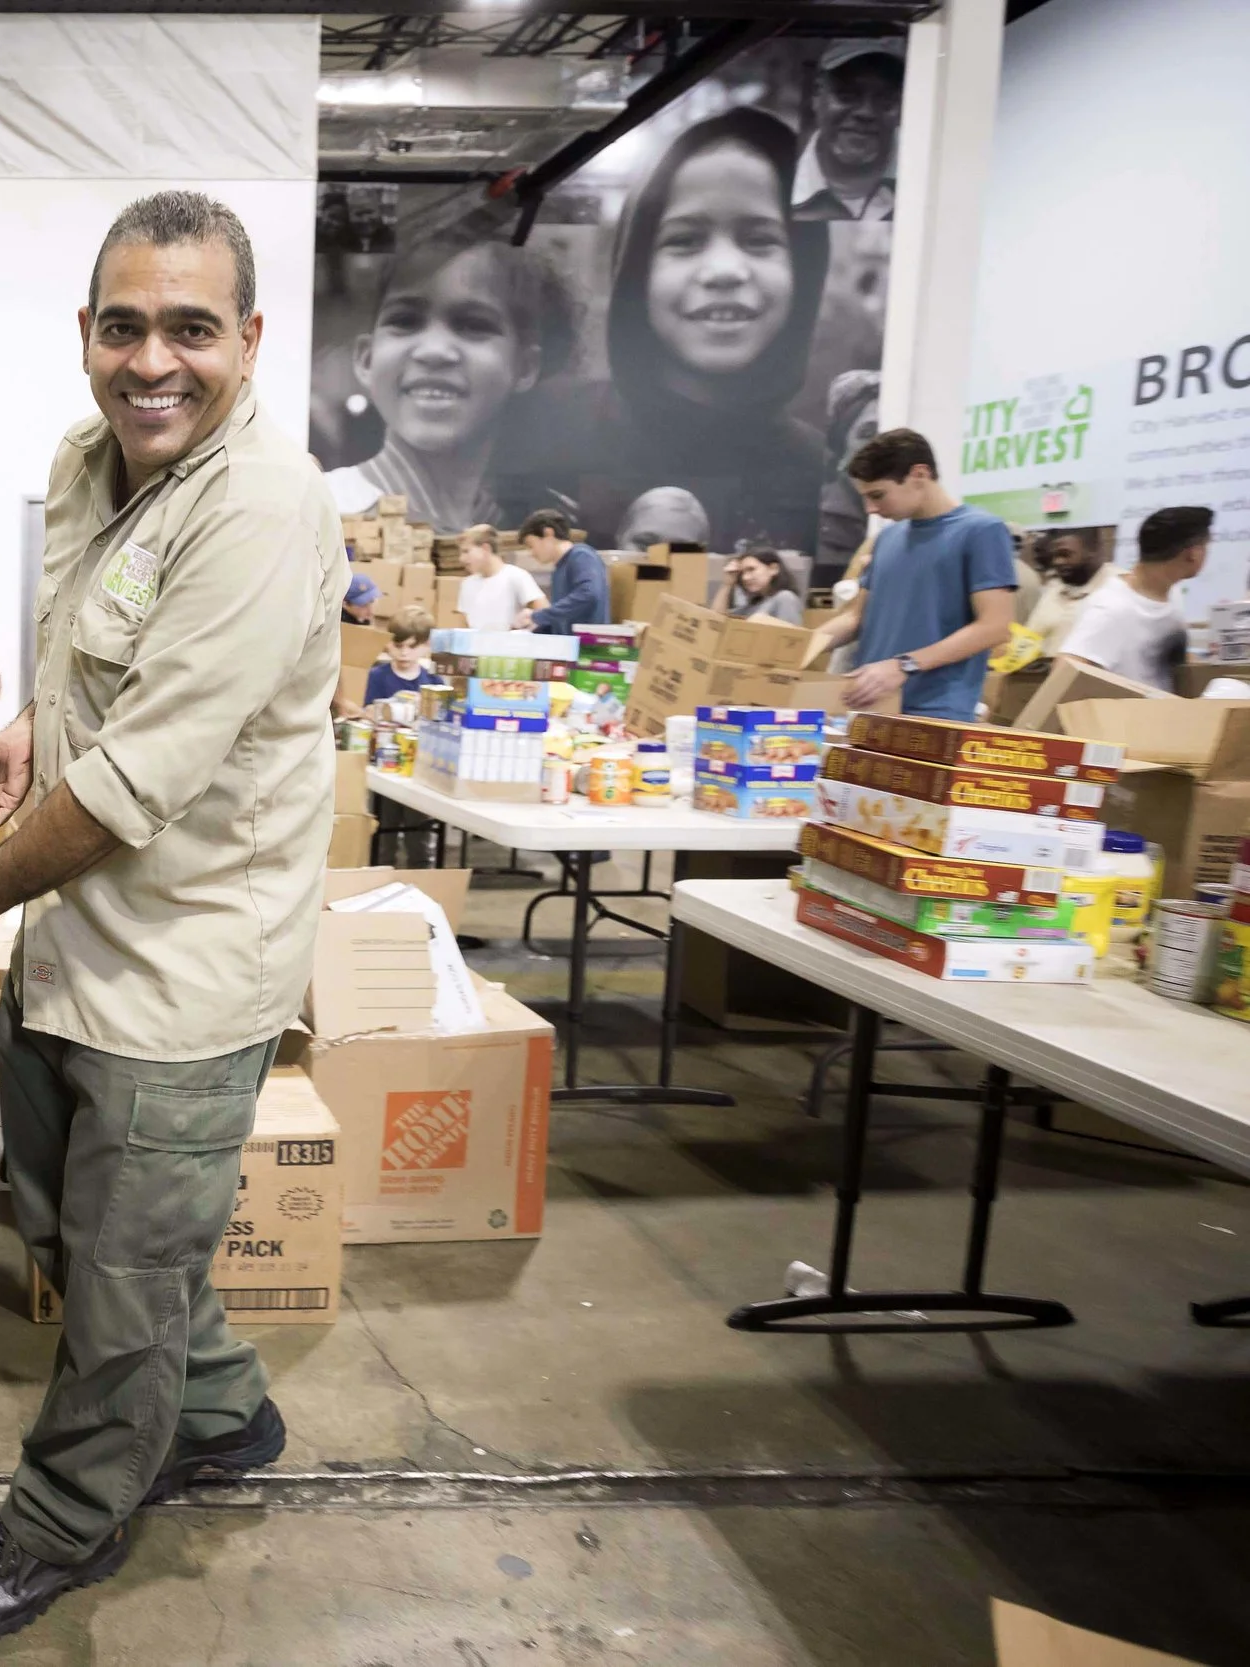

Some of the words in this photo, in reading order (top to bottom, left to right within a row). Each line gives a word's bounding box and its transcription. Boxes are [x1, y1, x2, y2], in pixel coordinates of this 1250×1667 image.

[963, 397, 1020, 438] ITY
[382, 1089, 470, 1169] HOME
[279, 1142, 333, 1165] 18315
[227, 1240, 285, 1258] PACK
